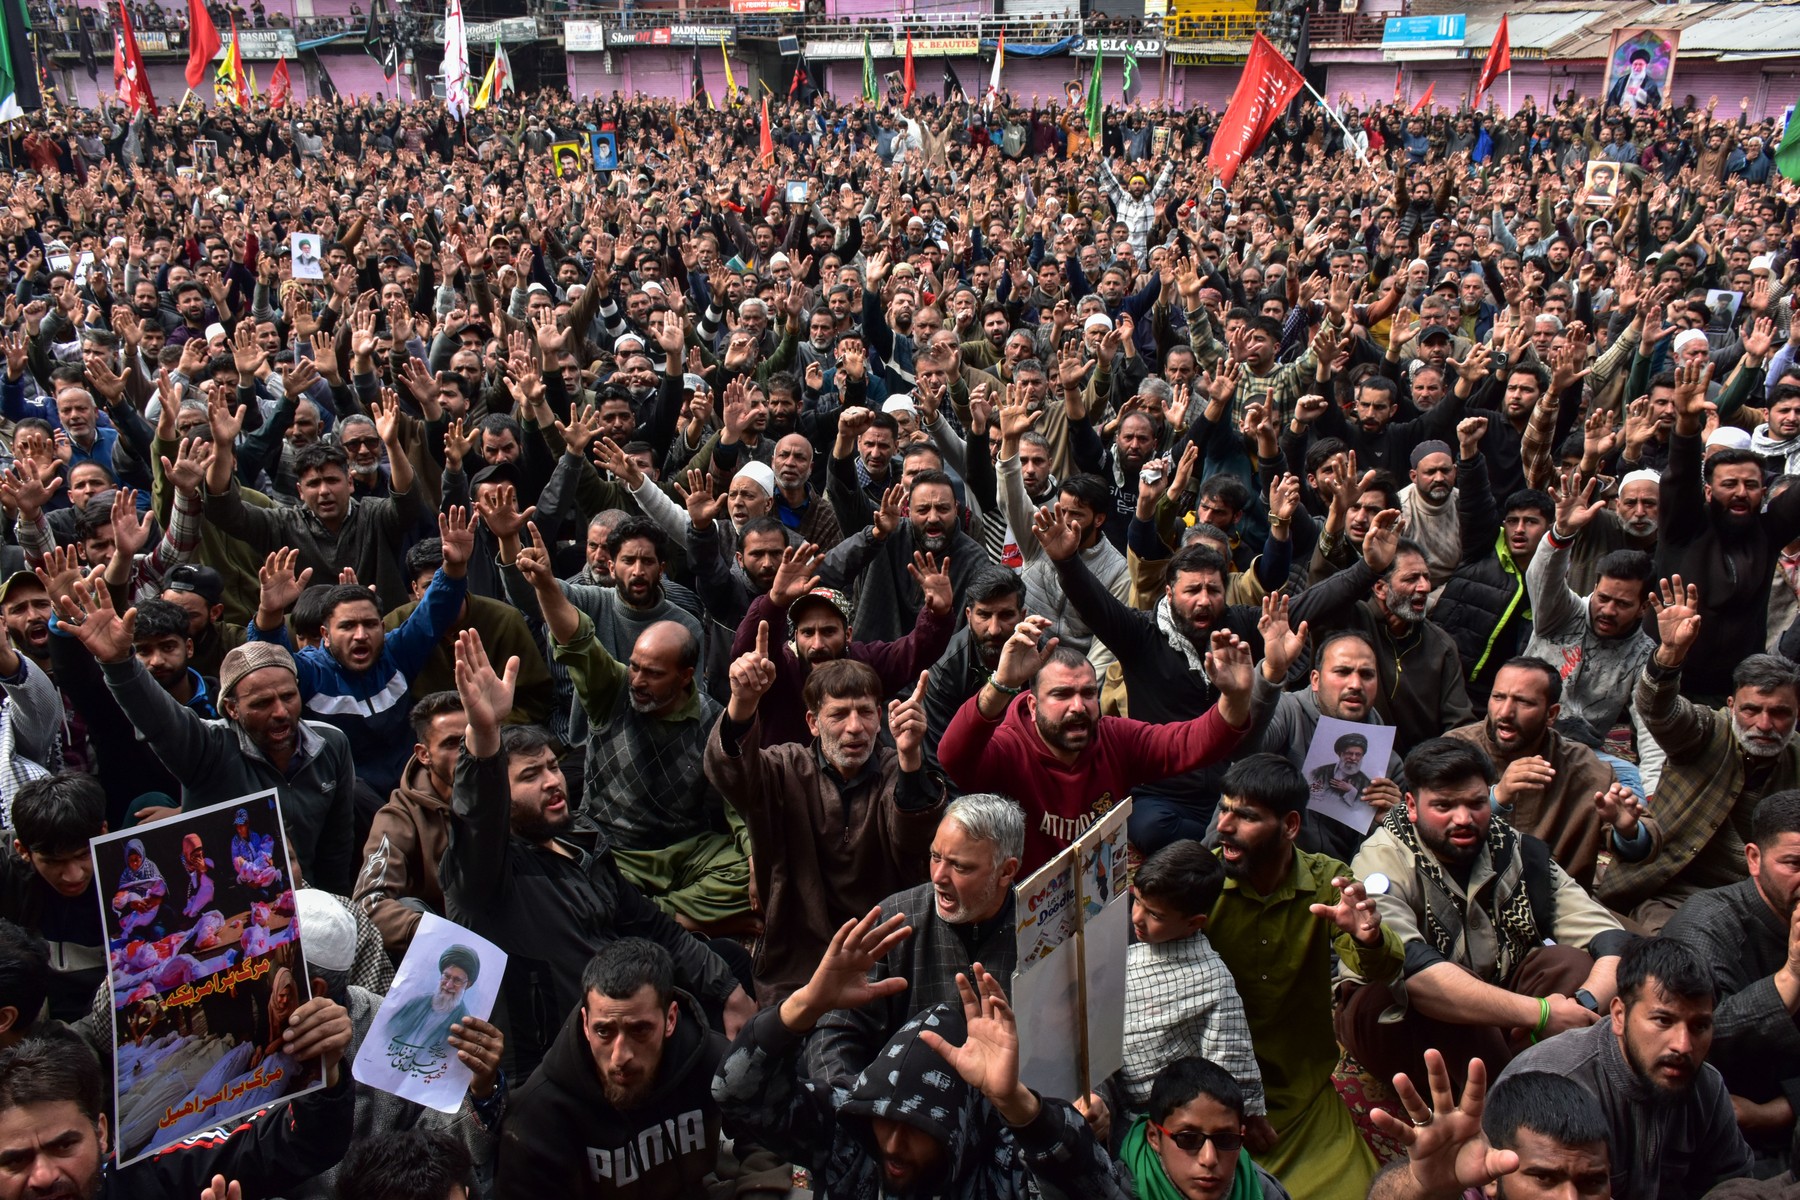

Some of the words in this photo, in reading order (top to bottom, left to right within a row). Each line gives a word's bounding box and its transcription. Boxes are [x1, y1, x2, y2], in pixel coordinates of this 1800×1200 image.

[671, 26, 706, 35] MADINA
[240, 33, 277, 42] PASAND
[930, 39, 977, 49] BEAUTIES
